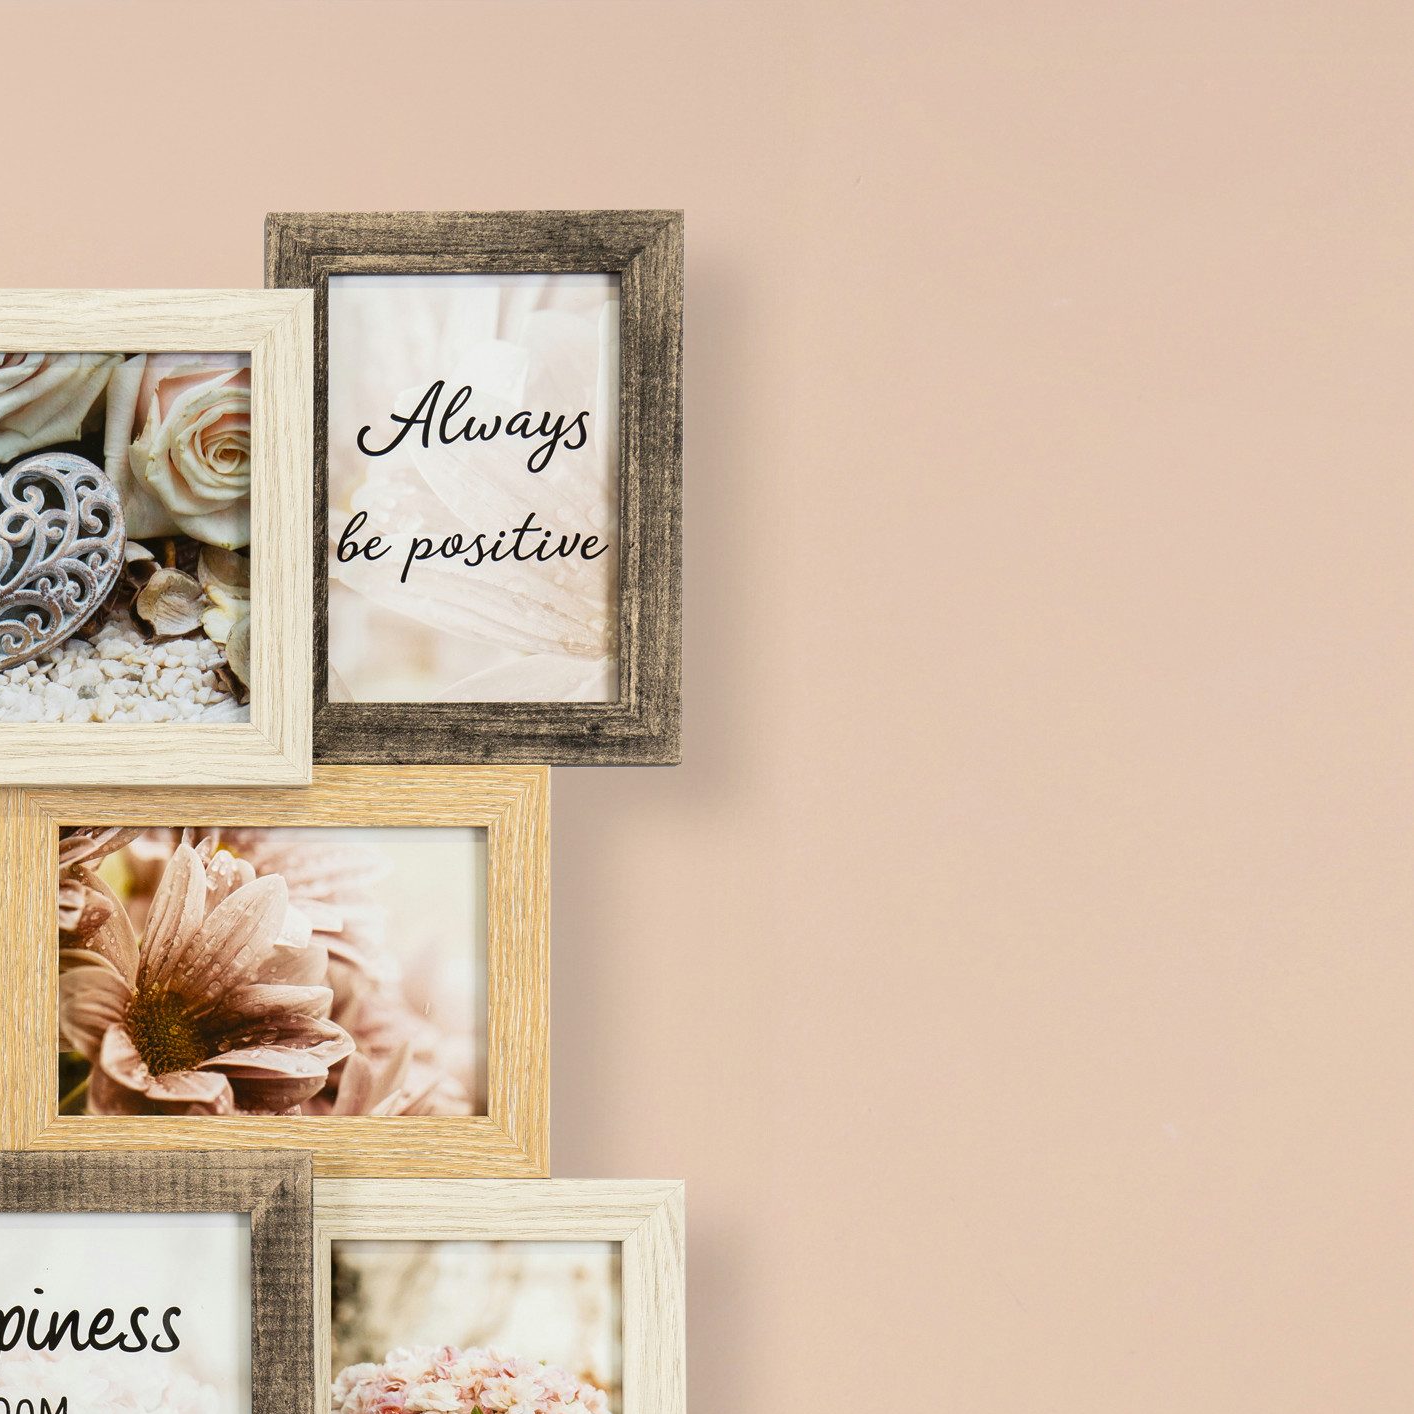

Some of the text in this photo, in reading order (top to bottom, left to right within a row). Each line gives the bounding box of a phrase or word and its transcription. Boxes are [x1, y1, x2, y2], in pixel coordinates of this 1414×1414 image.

[356, 379, 591, 475] Always
[335, 510, 611, 585] be positive
